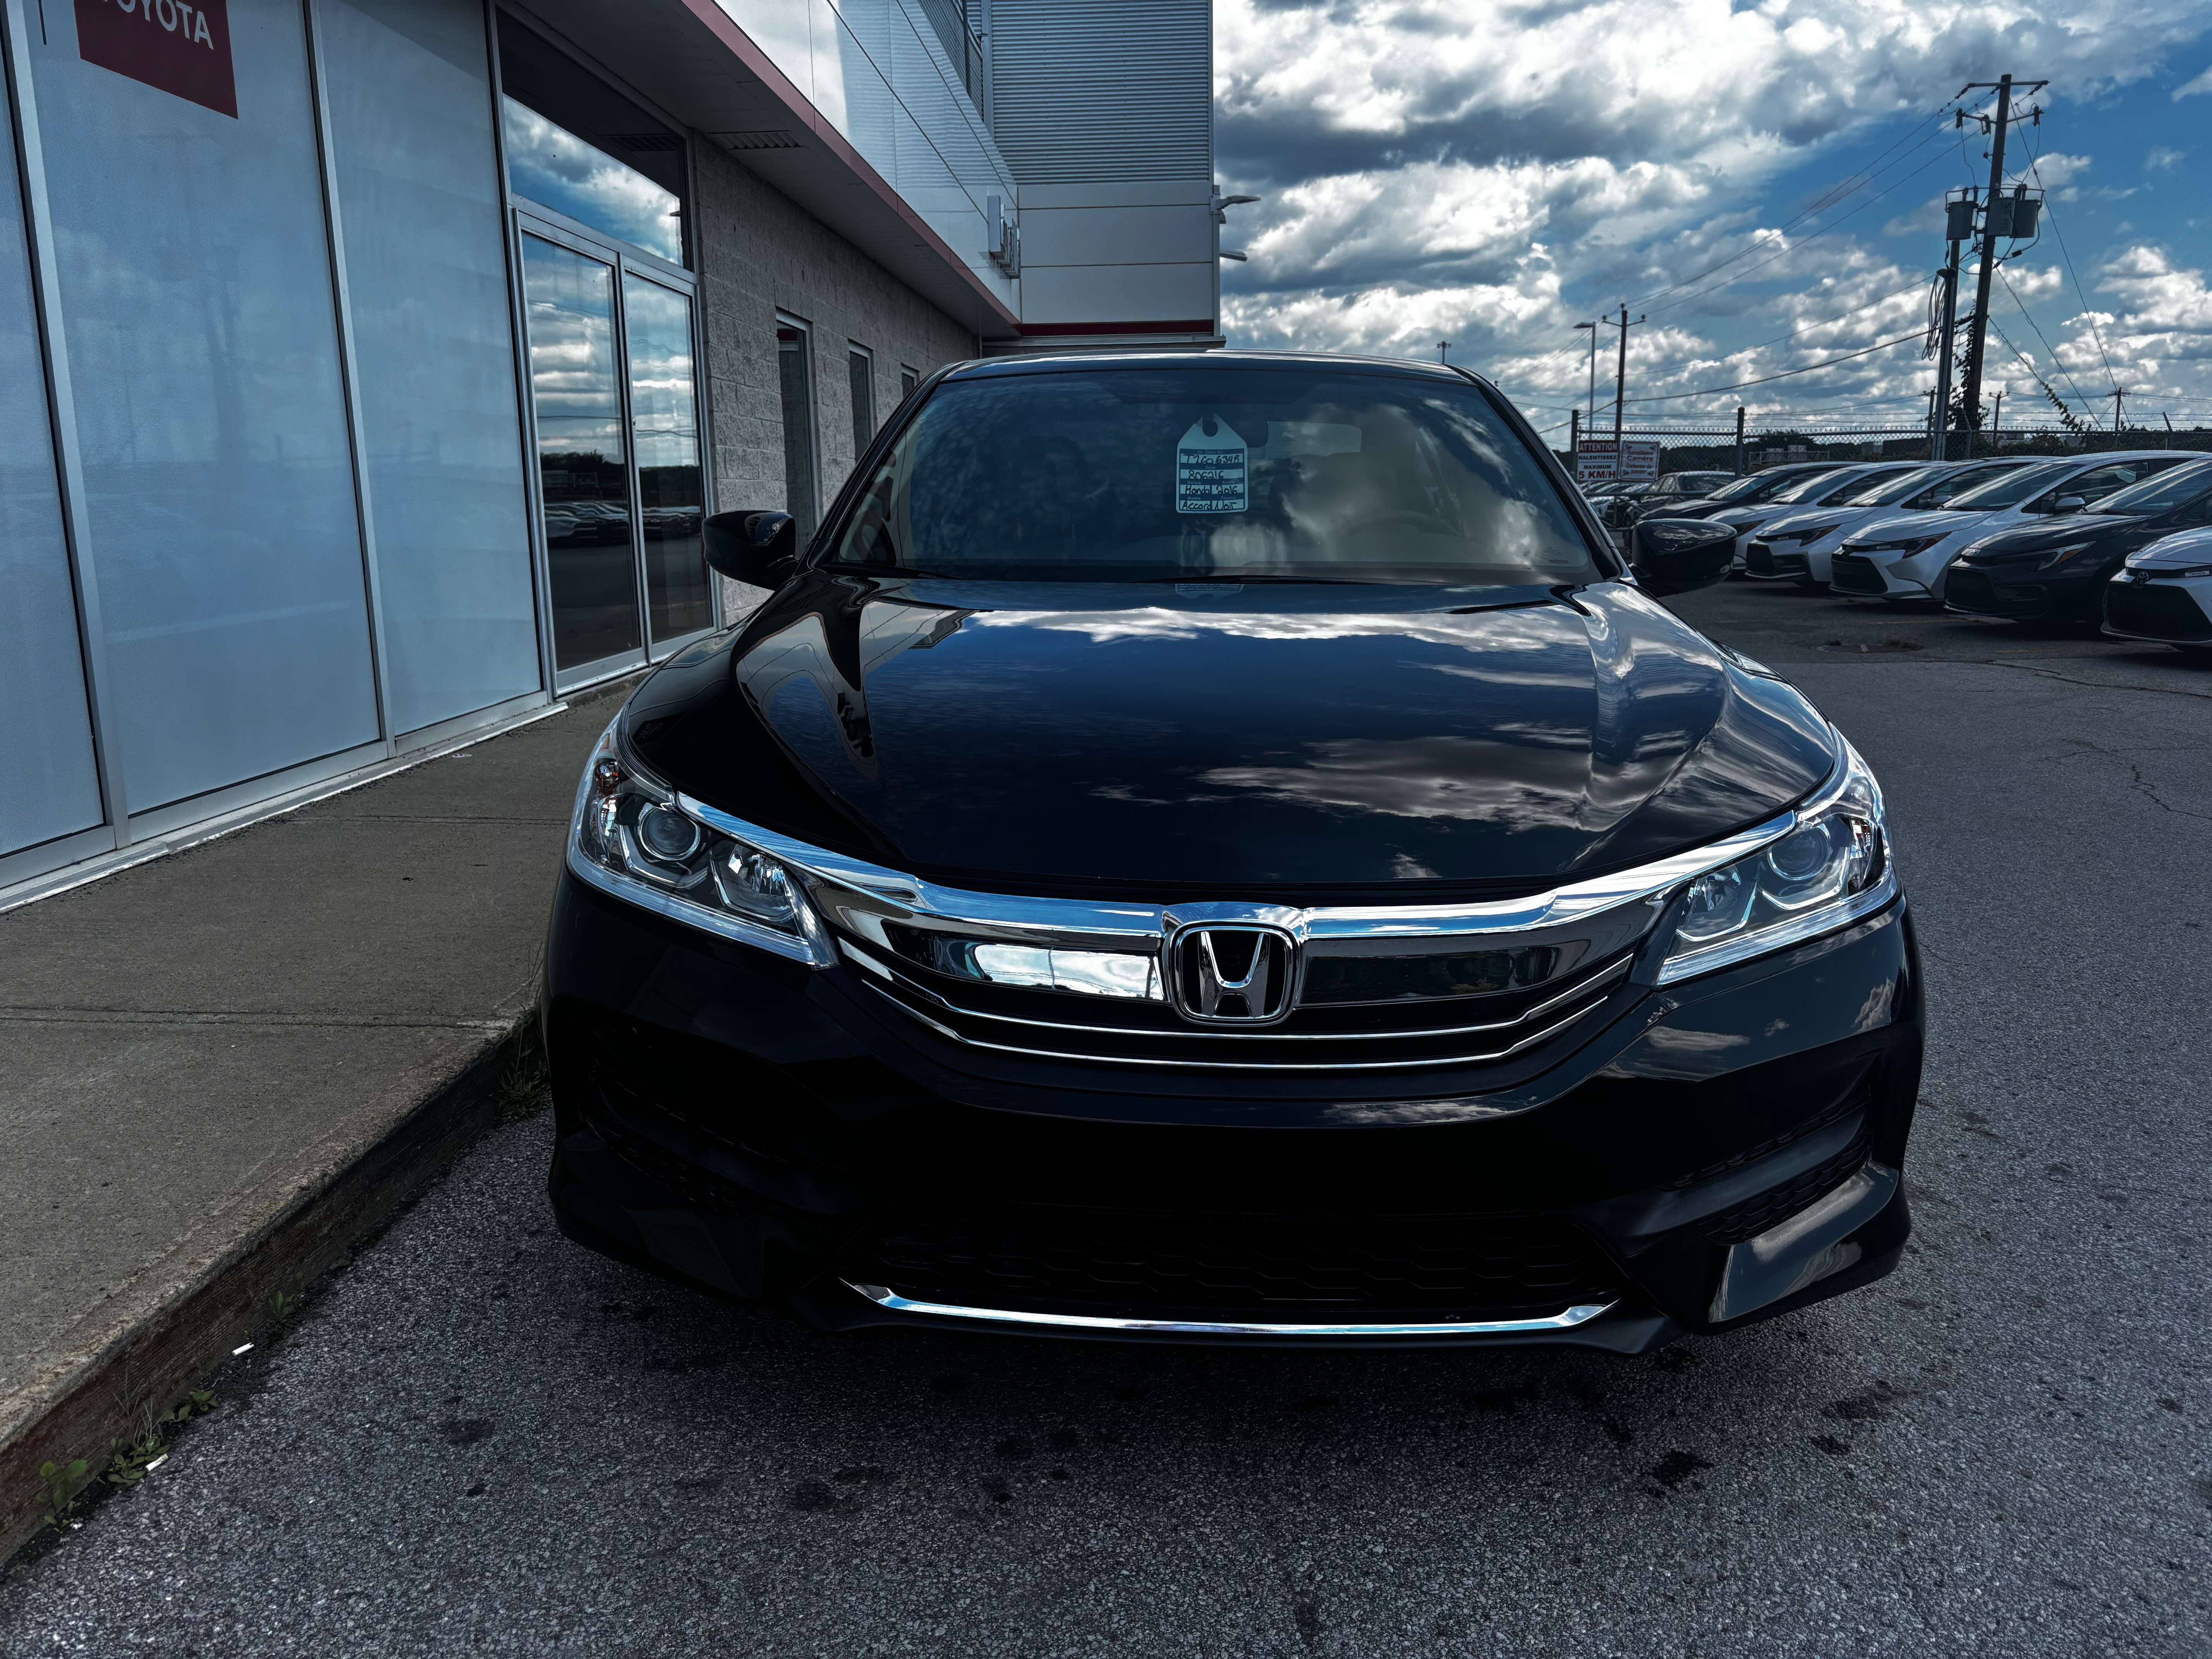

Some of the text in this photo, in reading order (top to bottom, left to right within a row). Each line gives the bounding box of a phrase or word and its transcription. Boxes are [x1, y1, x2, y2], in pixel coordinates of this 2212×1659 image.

[1580, 443, 1618, 452] ATTENTION
[1216, 485, 1237, 495] 2016
[1182, 500, 1237, 510] Accord Noir
